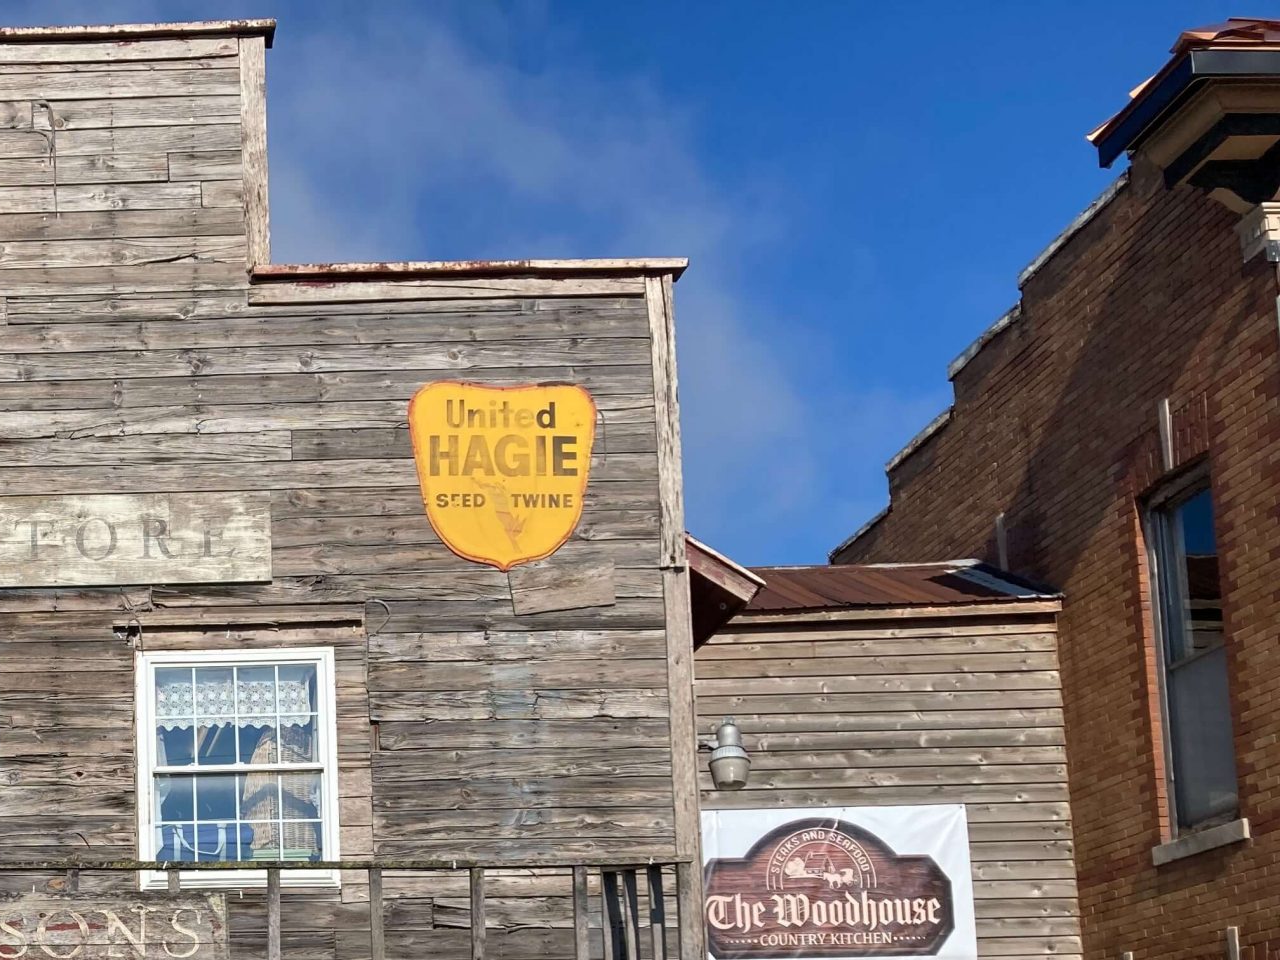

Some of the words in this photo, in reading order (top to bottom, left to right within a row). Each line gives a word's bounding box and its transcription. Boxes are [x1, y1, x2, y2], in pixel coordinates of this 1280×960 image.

[446, 399, 556, 429] United
[428, 434, 578, 477] HAGIE
[435, 493, 486, 508] SEED
[511, 493, 574, 508] TWINE
[770, 836, 801, 874] STEAKS
[802, 830, 826, 842] AND
[829, 831, 870, 873] SEAFOOD
[706, 892, 766, 934] The
[770, 890, 942, 931] Woodhouse
[759, 932, 826, 947] COUNTRY
[830, 931, 893, 945] KITCHEN
